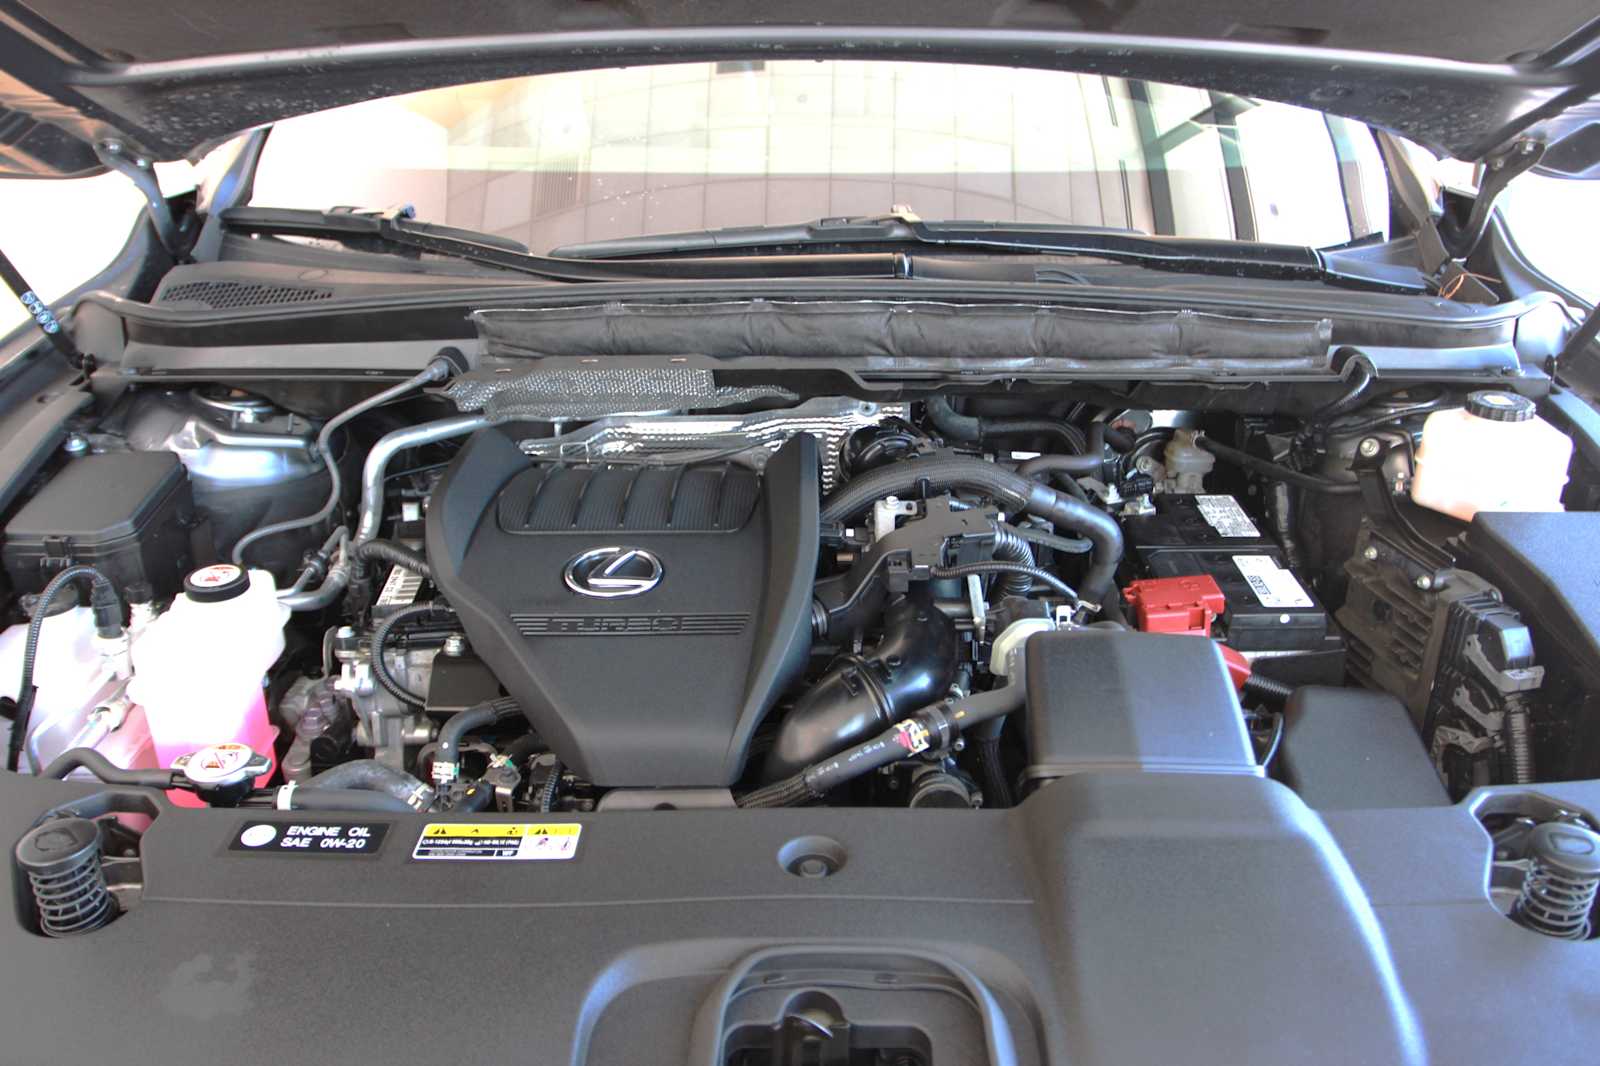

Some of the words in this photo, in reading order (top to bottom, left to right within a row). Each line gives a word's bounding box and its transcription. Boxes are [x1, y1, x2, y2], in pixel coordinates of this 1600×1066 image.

[286, 825, 342, 836] ENGINE
[348, 827, 371, 837] OIL
[280, 837, 313, 848] SAE
[319, 838, 366, 848] 0W-20
